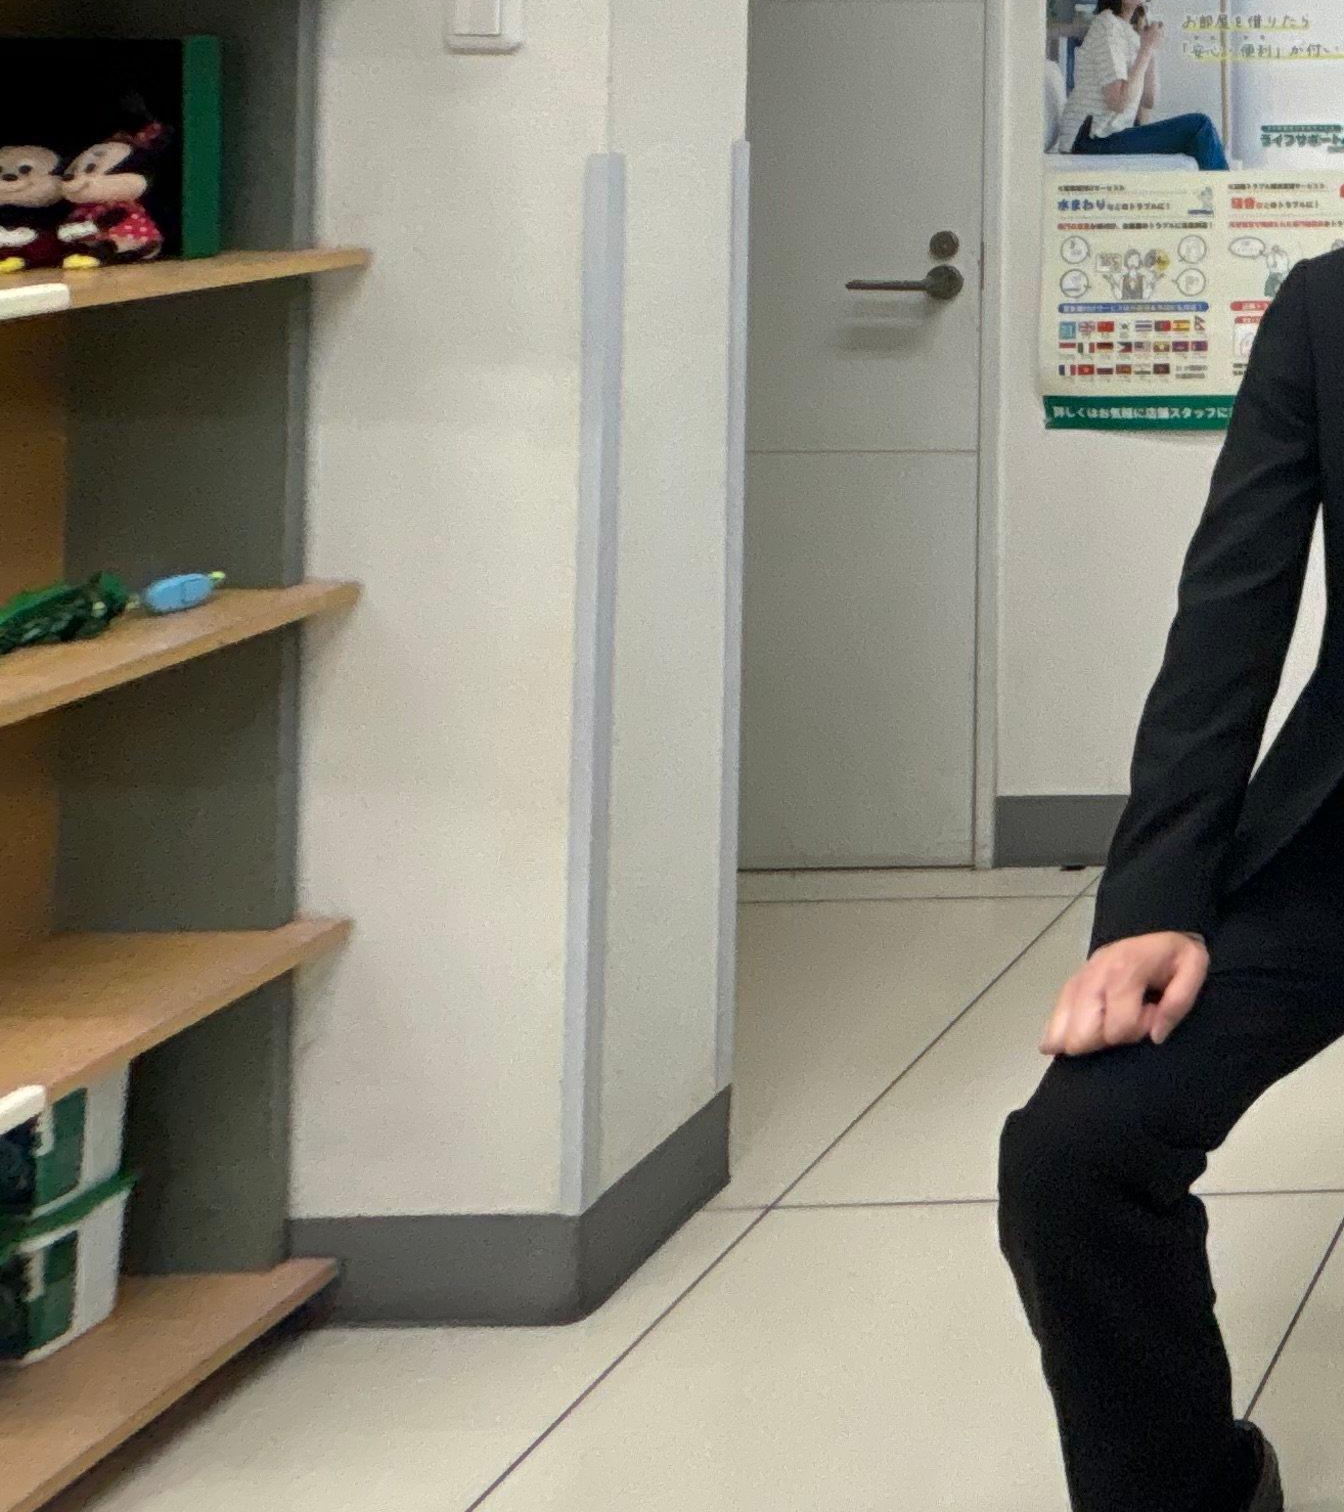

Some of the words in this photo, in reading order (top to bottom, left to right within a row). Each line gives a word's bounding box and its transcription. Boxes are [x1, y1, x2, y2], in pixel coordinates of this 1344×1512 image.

[1053, 405, 1232, 420] 詳しくはお気軽に店舗スタッフに
